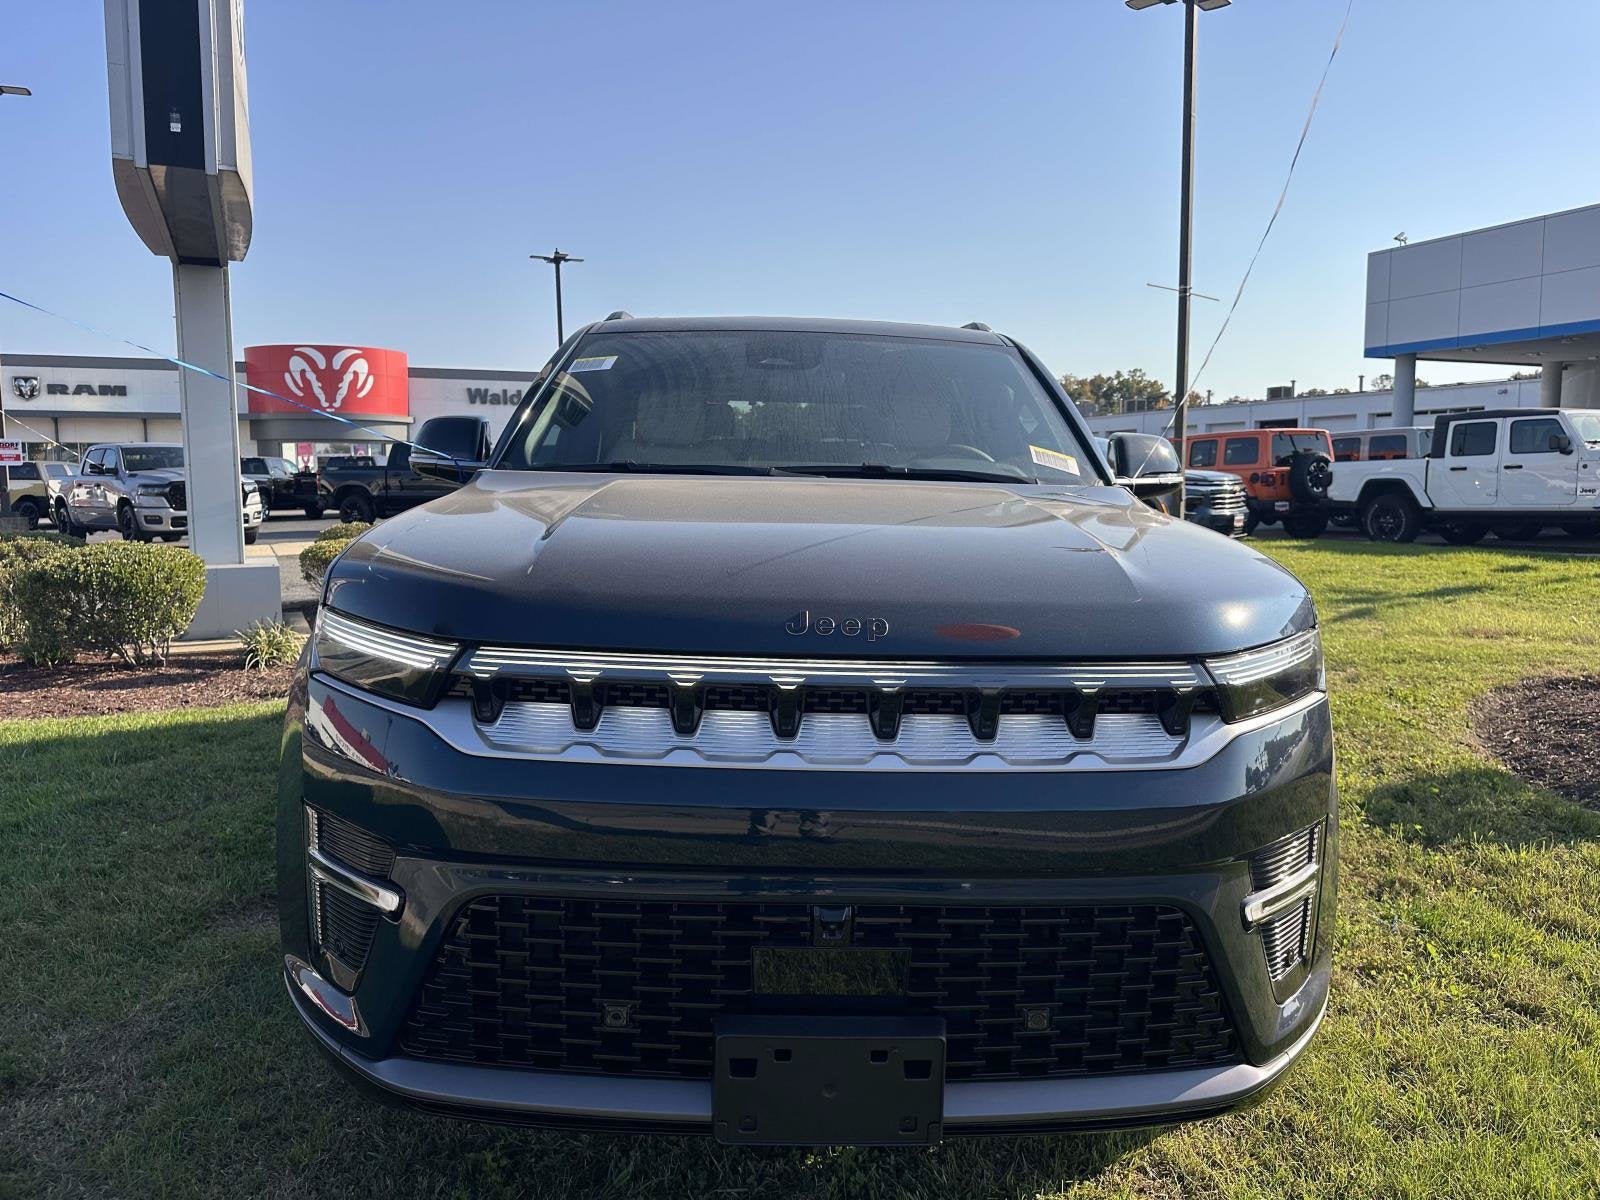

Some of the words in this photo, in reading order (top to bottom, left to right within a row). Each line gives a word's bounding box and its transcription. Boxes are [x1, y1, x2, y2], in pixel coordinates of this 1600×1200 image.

[46, 383, 128, 397] RAM
[466, 387, 522, 406] Wald
[785, 610, 889, 641] Jeep
